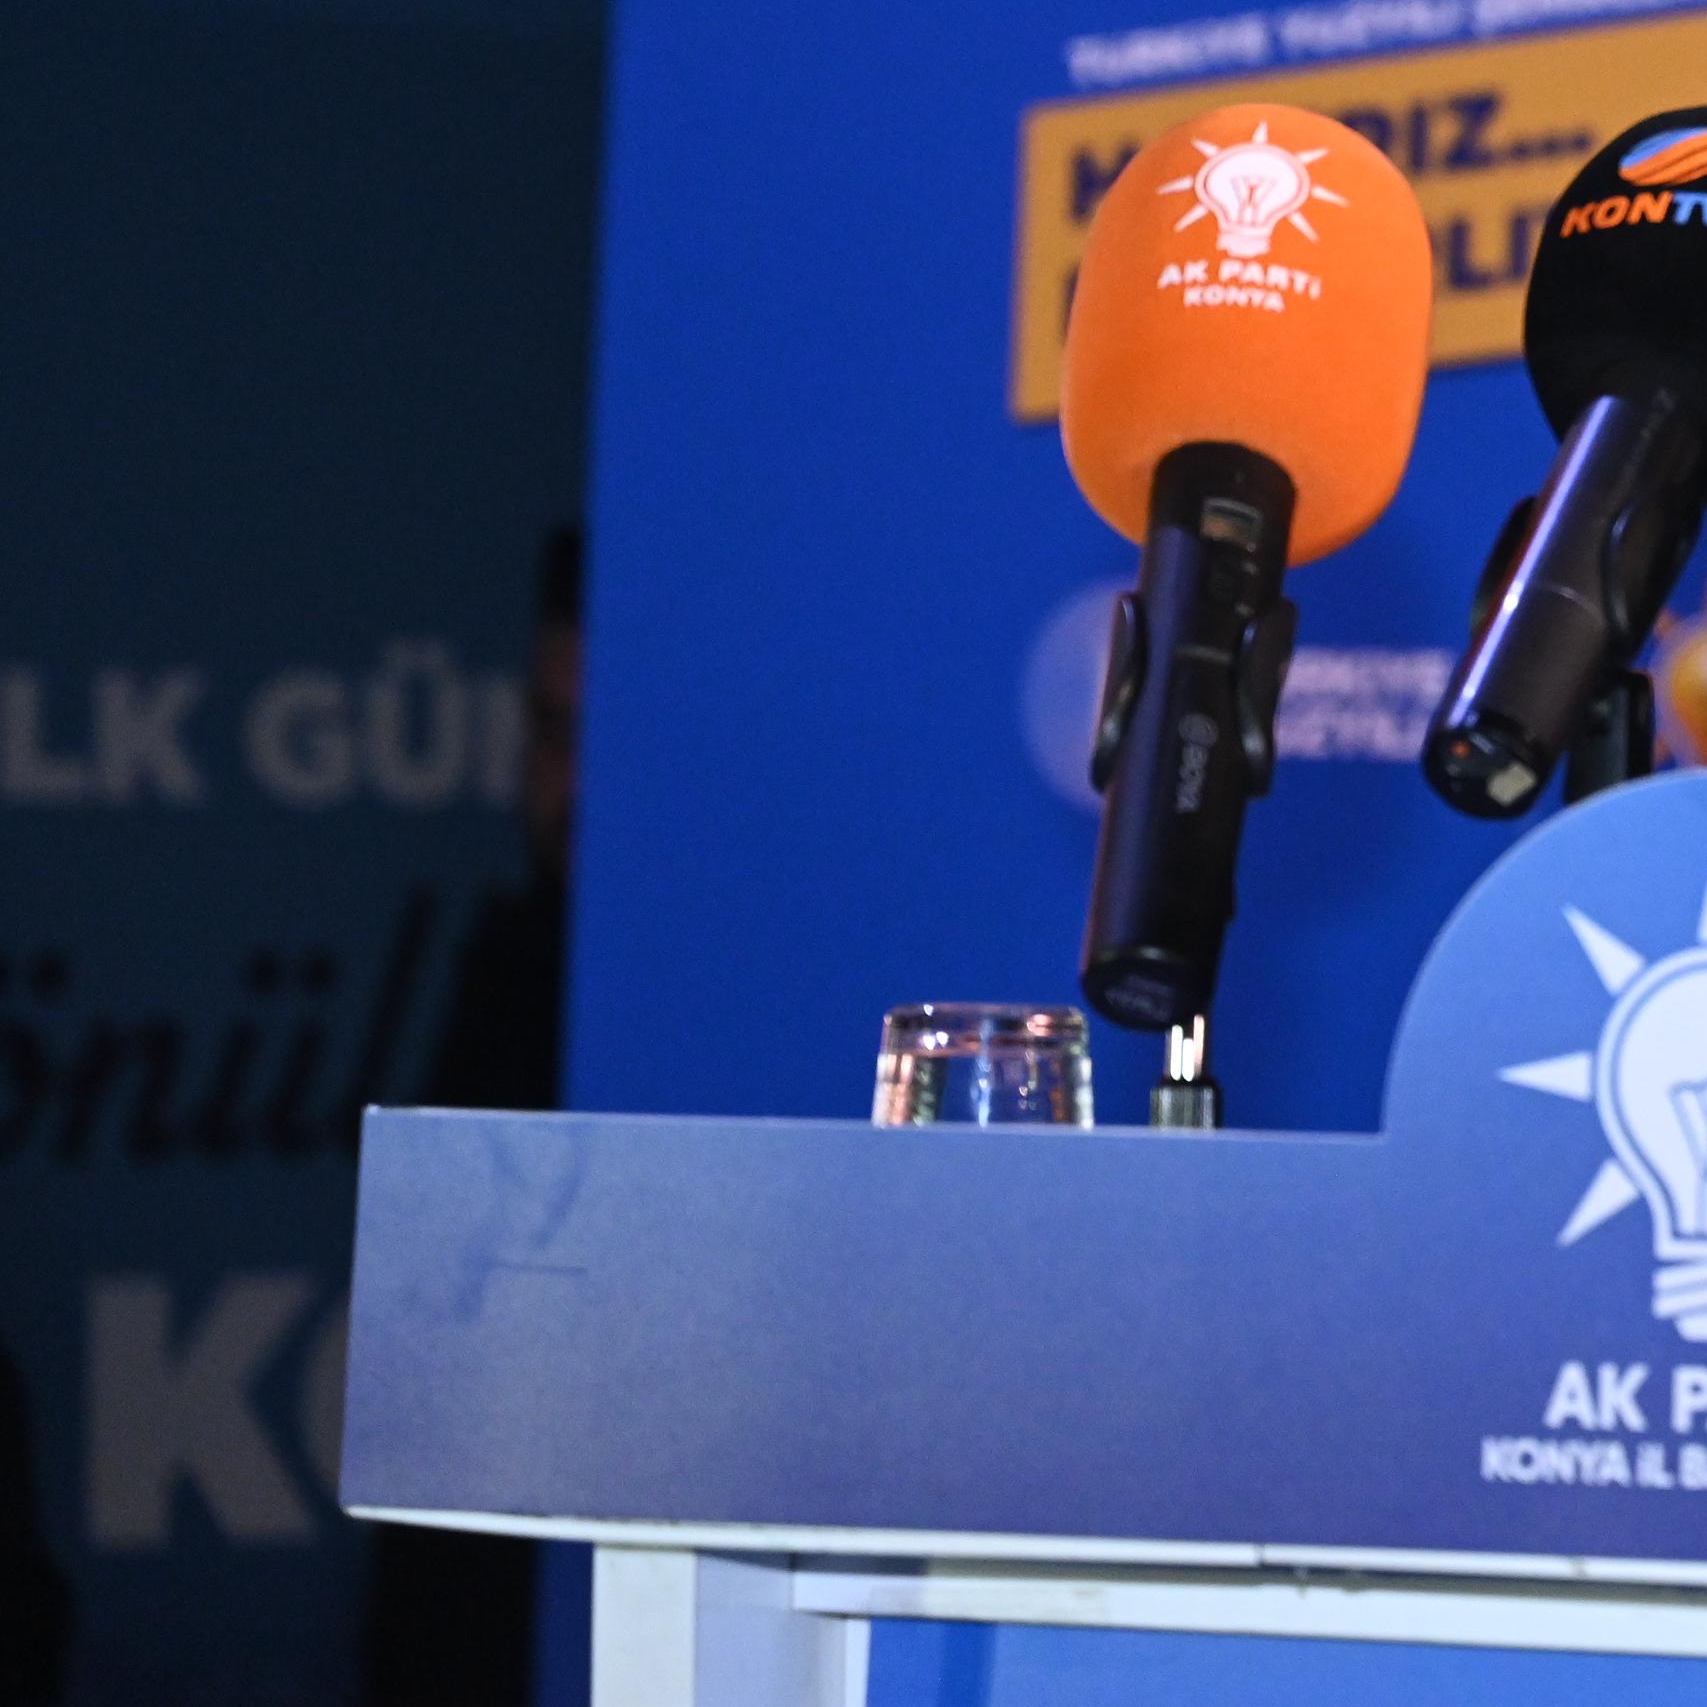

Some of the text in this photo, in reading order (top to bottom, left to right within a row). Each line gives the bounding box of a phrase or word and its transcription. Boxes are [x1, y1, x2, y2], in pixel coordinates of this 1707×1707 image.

[1157, 259, 1208, 291] AK
[1543, 1360, 1652, 1435] AK
[1479, 1435, 1631, 1488] KONYA
